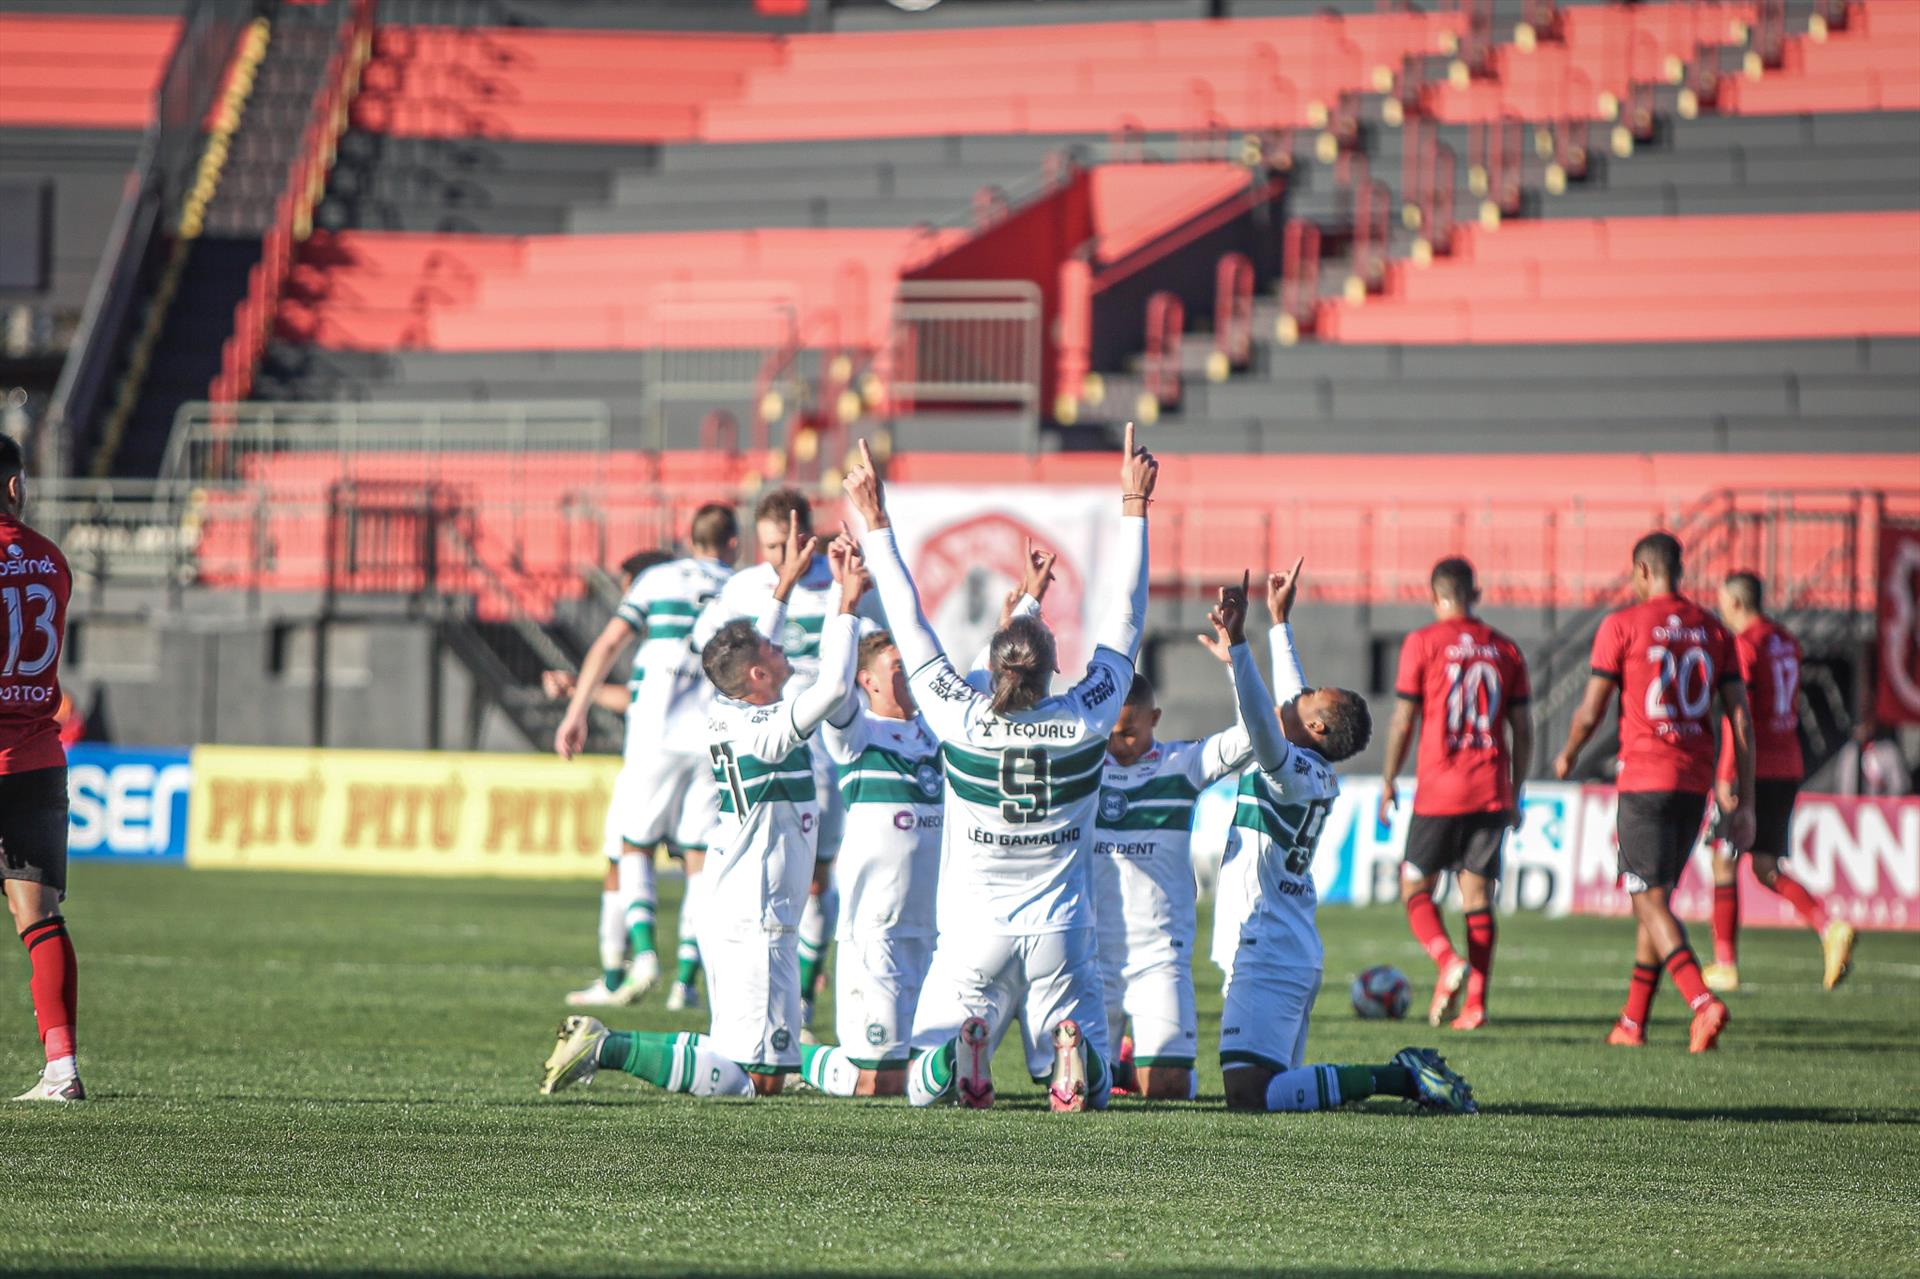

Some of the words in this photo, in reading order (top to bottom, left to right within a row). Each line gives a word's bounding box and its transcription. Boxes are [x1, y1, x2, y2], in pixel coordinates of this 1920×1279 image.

[1, 583, 58, 676] 13
[1445, 661, 1502, 733] 10
[1645, 646, 1714, 720] 20
[1771, 656, 1799, 717] 17
[1005, 722, 1077, 739] TEQUALY
[1000, 746, 1050, 824] 9
[918, 816, 943, 828] NEO
[1000, 827, 1080, 846] GAMALHO
